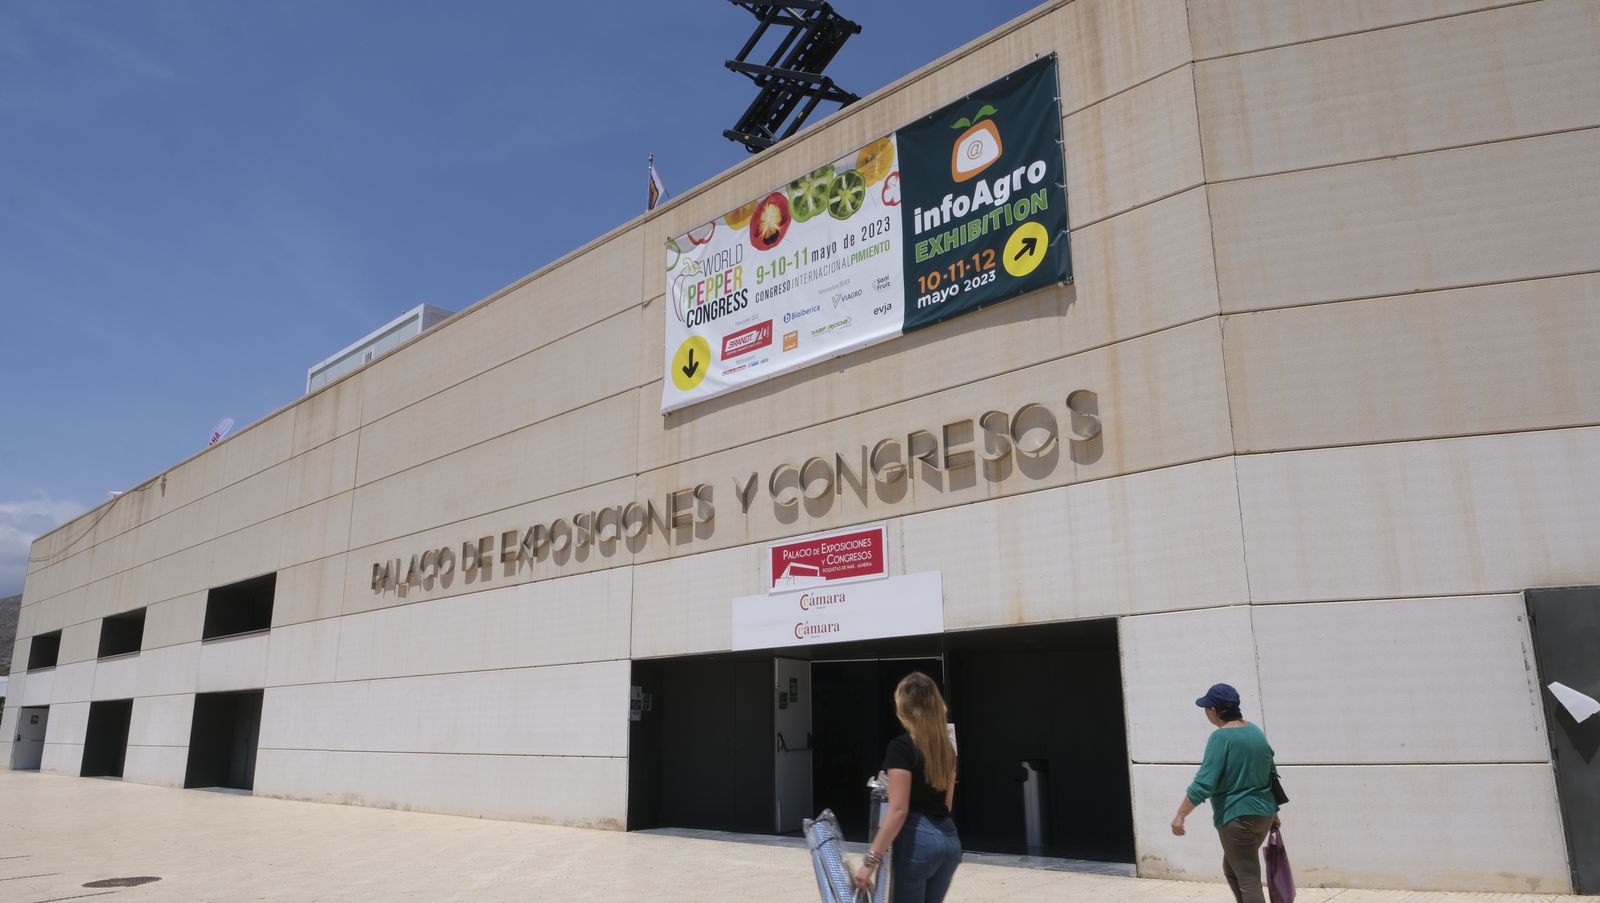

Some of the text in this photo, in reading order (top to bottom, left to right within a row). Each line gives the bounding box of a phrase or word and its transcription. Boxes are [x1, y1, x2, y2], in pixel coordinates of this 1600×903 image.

[913, 160, 1047, 235] infoAgro
[914, 188, 1049, 264] EXHIBITION
[702, 243, 744, 278] WORLD
[756, 215, 891, 285] 9-10-11 mayo de 2023
[687, 266, 744, 309] PEPPER
[841, 289, 863, 302] VIAGRO
[917, 269, 997, 309] mayo 2023
[686, 288, 749, 329] CONGRESS
[873, 302, 893, 316] evja
[371, 388, 1104, 594] PALACIO DE EXPOSICIONES Y CONGRESOS
[783, 547, 812, 561] PALACIO
[821, 537, 872, 555] EXPOSICIONES
[826, 550, 872, 566] CONGRESOS
[800, 592, 846, 611] Cámara
[794, 621, 841, 639] Cámara
